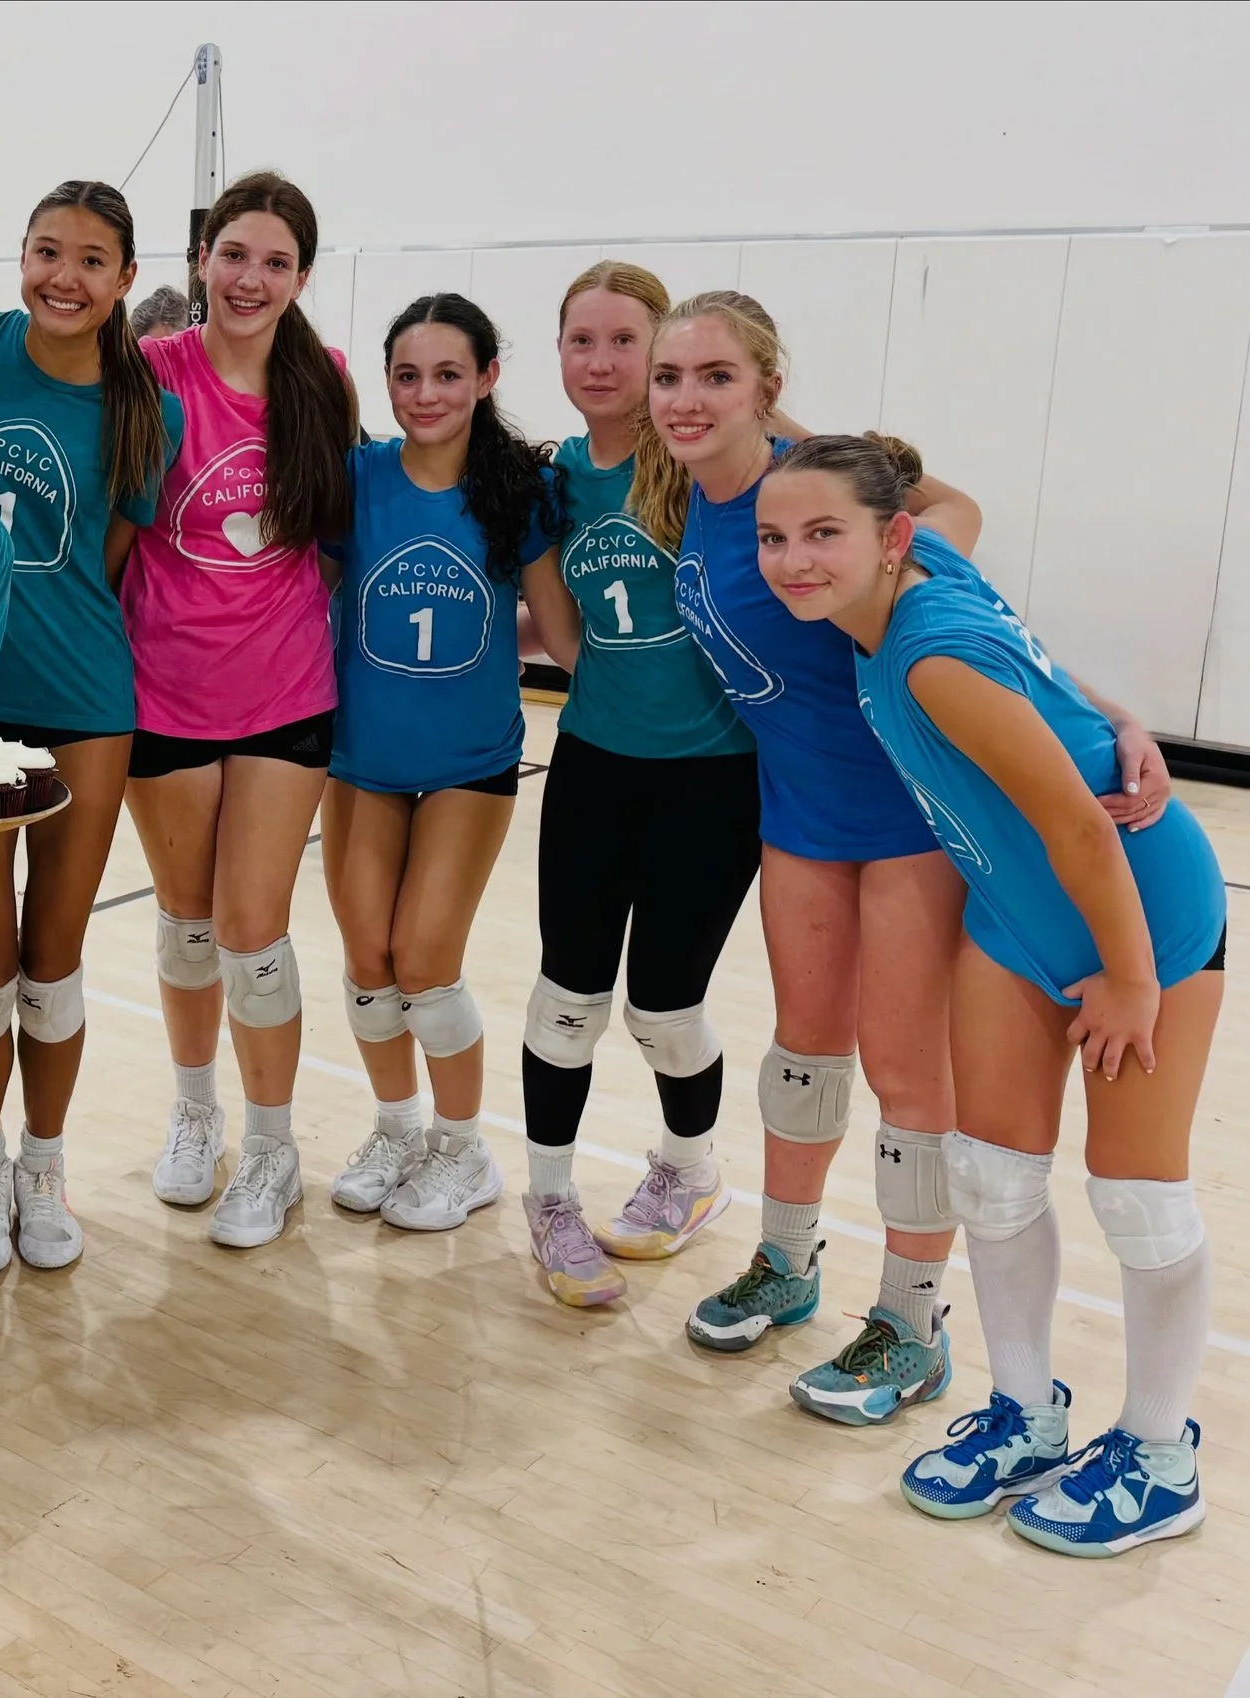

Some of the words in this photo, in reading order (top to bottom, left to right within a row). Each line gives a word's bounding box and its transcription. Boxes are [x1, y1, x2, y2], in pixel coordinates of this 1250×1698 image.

[224, 467, 266, 480] PCV
[202, 483, 268, 506] CALIFO
[585, 534, 636, 552] PCVC
[398, 561, 459, 579] PCVC
[571, 554, 659, 578] CALIFORNIA
[378, 582, 474, 603] CALIFORNIA
[603, 580, 633, 634] 1
[409, 608, 433, 661] 1
